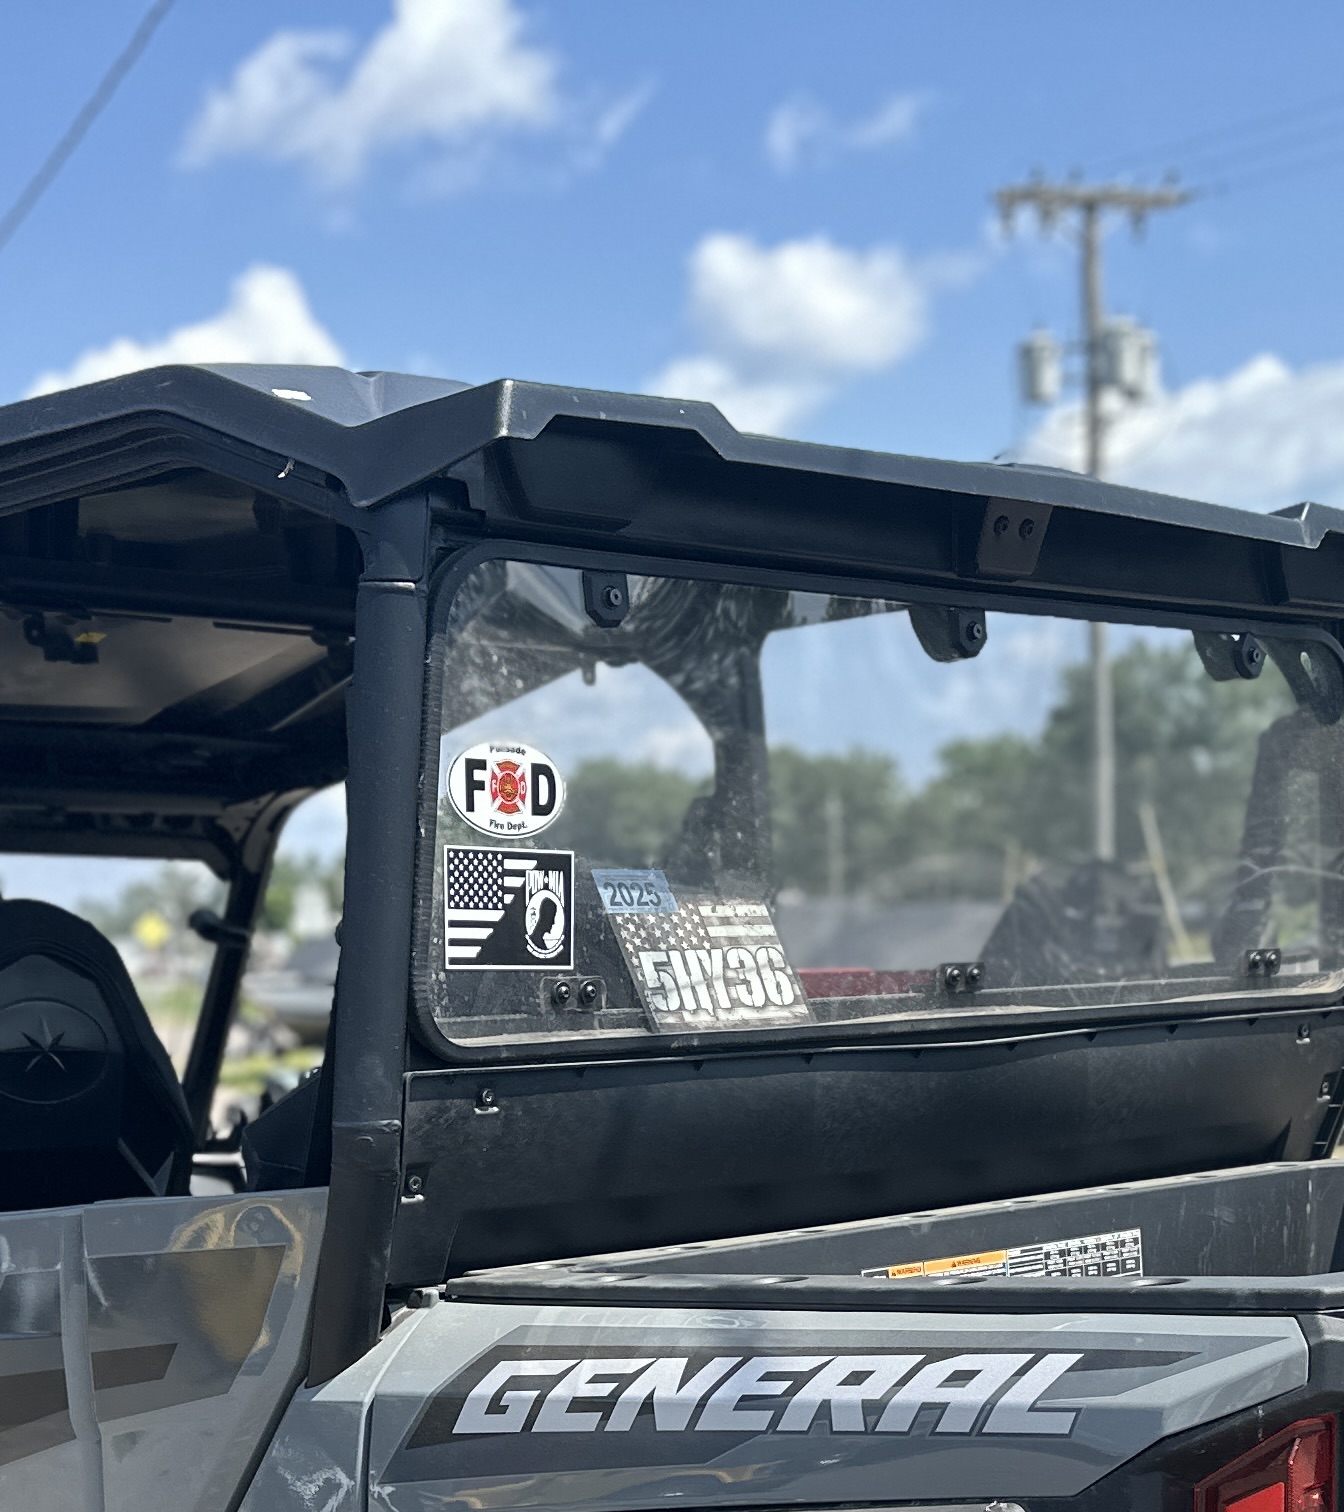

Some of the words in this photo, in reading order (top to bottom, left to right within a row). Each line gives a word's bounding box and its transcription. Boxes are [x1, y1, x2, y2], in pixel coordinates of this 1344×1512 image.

[465, 758, 487, 812] F
[531, 763, 556, 816] D
[489, 819, 504, 830] Fire
[603, 882, 662, 907] 2025
[452, 1353, 1085, 1435] GENERAL
